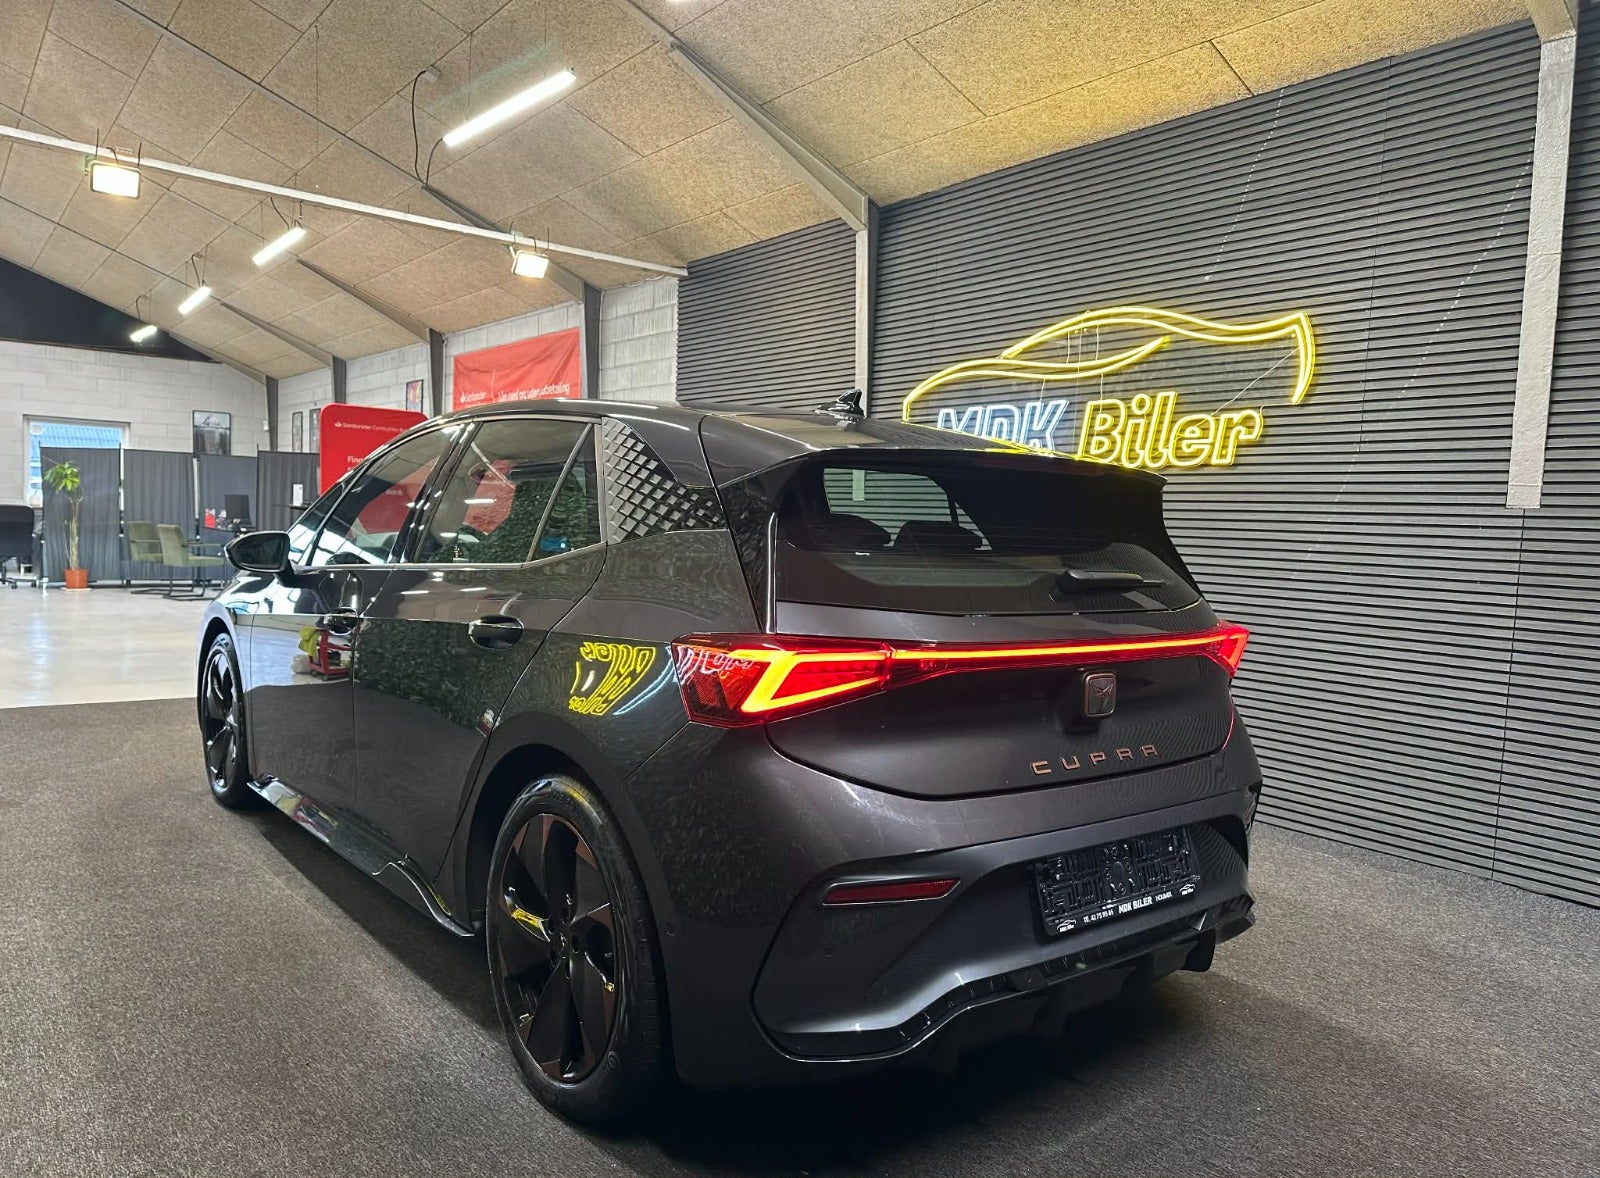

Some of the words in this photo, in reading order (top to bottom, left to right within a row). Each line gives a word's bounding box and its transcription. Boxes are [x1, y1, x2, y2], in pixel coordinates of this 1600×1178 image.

[342, 422, 372, 430] Santander
[1077, 391, 1263, 470] Biler
[1031, 744, 1158, 775] CUPRA
[1118, 901, 1132, 914] MDK
[1132, 896, 1153, 910] BILER
